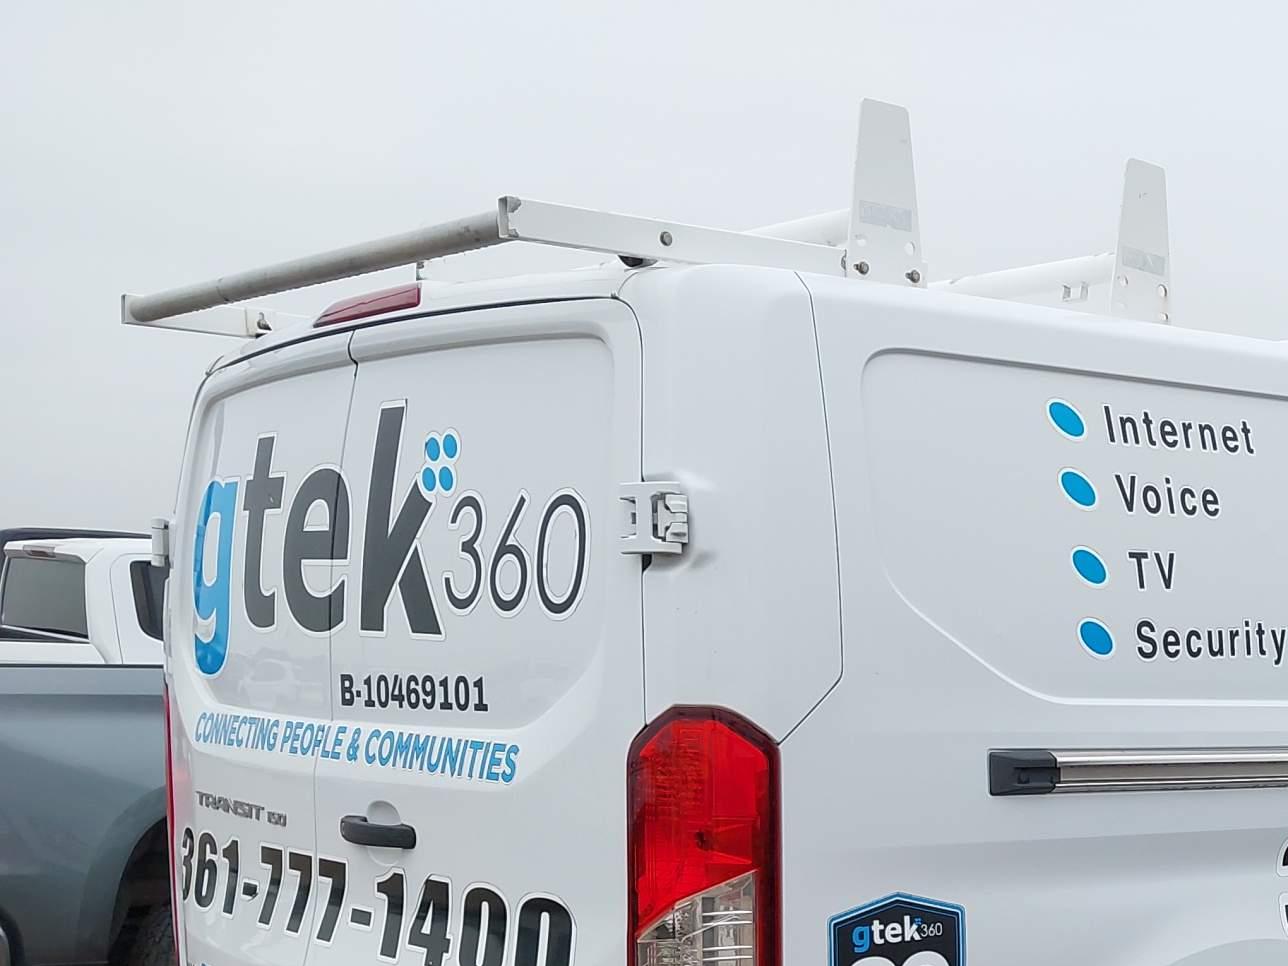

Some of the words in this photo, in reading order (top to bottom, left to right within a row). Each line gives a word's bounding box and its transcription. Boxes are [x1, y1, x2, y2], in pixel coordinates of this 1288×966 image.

[1103, 405, 1255, 454] Internet
[1114, 474, 1220, 517] Voice
[193, 398, 588, 676] gtek360
[1128, 551, 1175, 590] TV
[1137, 620, 1286, 666] Security
[340, 674, 489, 712] B-10469101
[195, 712, 279, 751] CONNECTING
[281, 721, 347, 759] PEOPLE
[346, 728, 361, 761] &
[364, 729, 520, 784] COMMUNITIES
